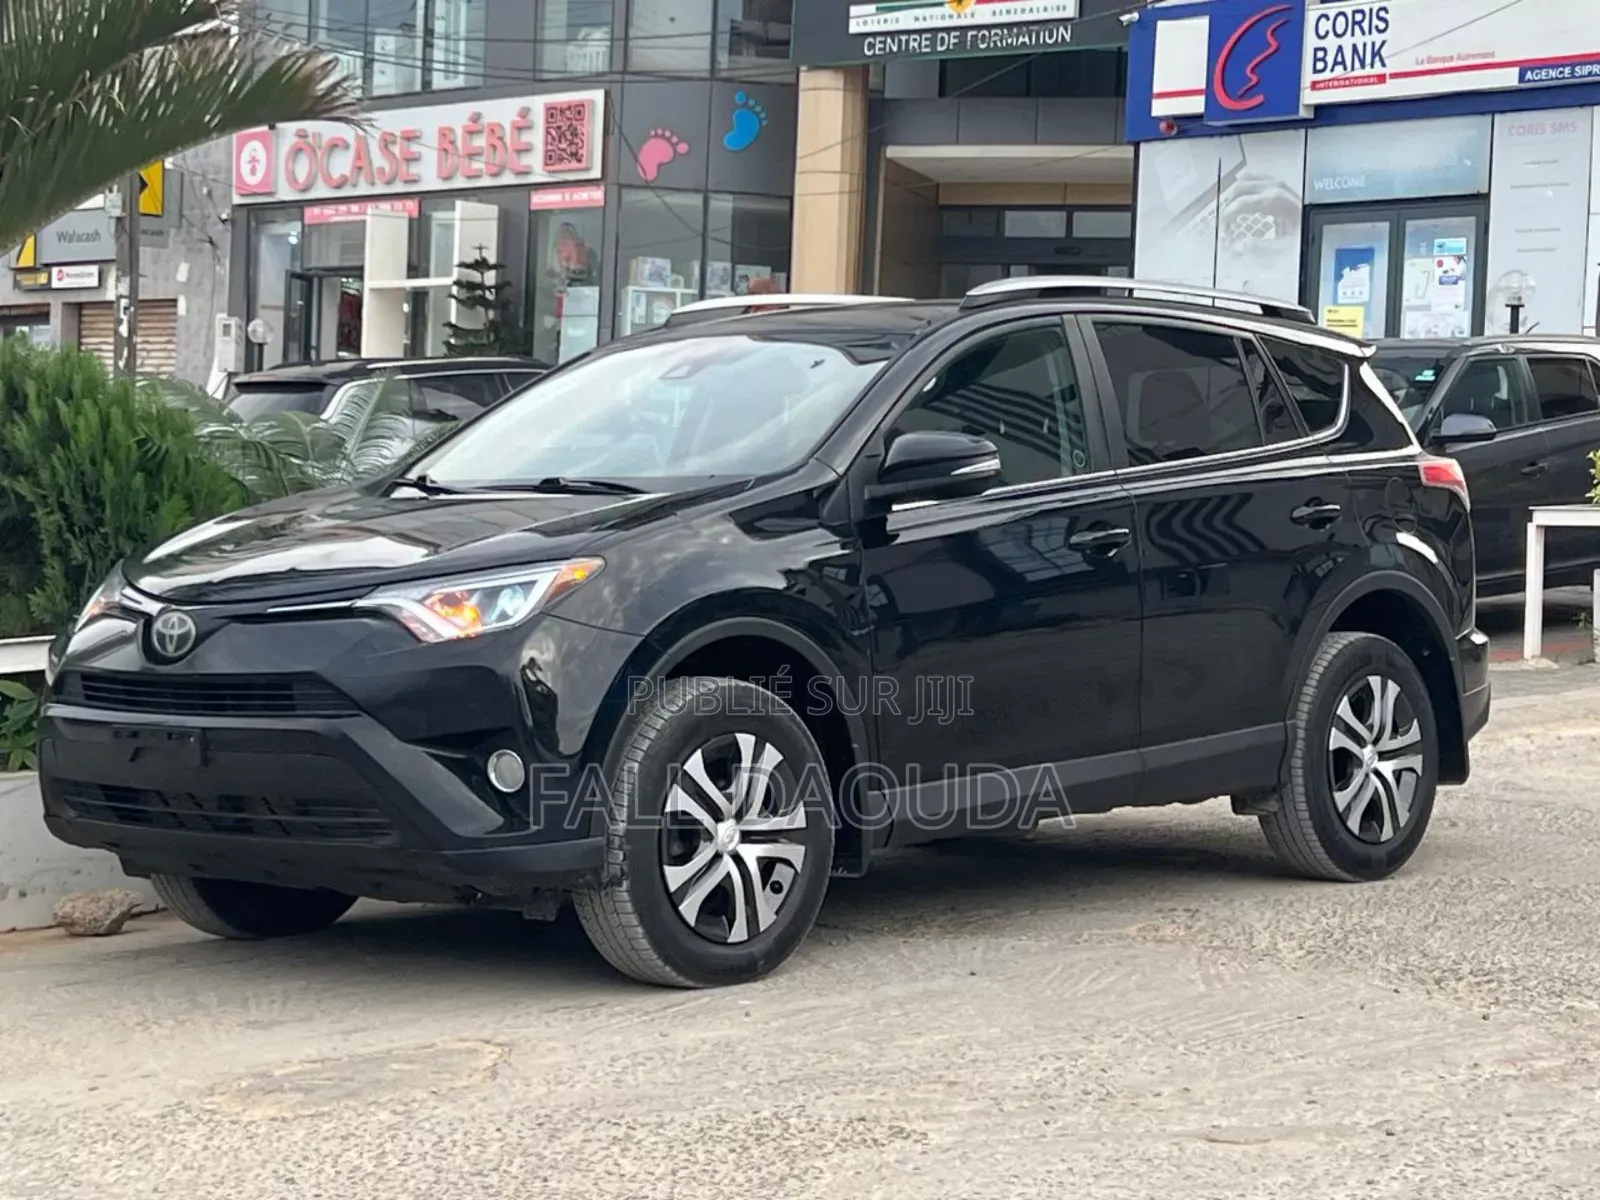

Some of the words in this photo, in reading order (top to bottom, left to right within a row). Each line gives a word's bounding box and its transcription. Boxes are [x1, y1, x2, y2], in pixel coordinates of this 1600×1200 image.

[1315, 6, 1389, 40] CORIS
[863, 32, 932, 56] CENTRE
[967, 24, 1072, 49] FORMATION
[1312, 40, 1387, 74] BANK
[1525, 66, 1573, 82] AGENCE
[437, 105, 534, 181] BÉBÉ
[1550, 121, 1580, 135] SMS
